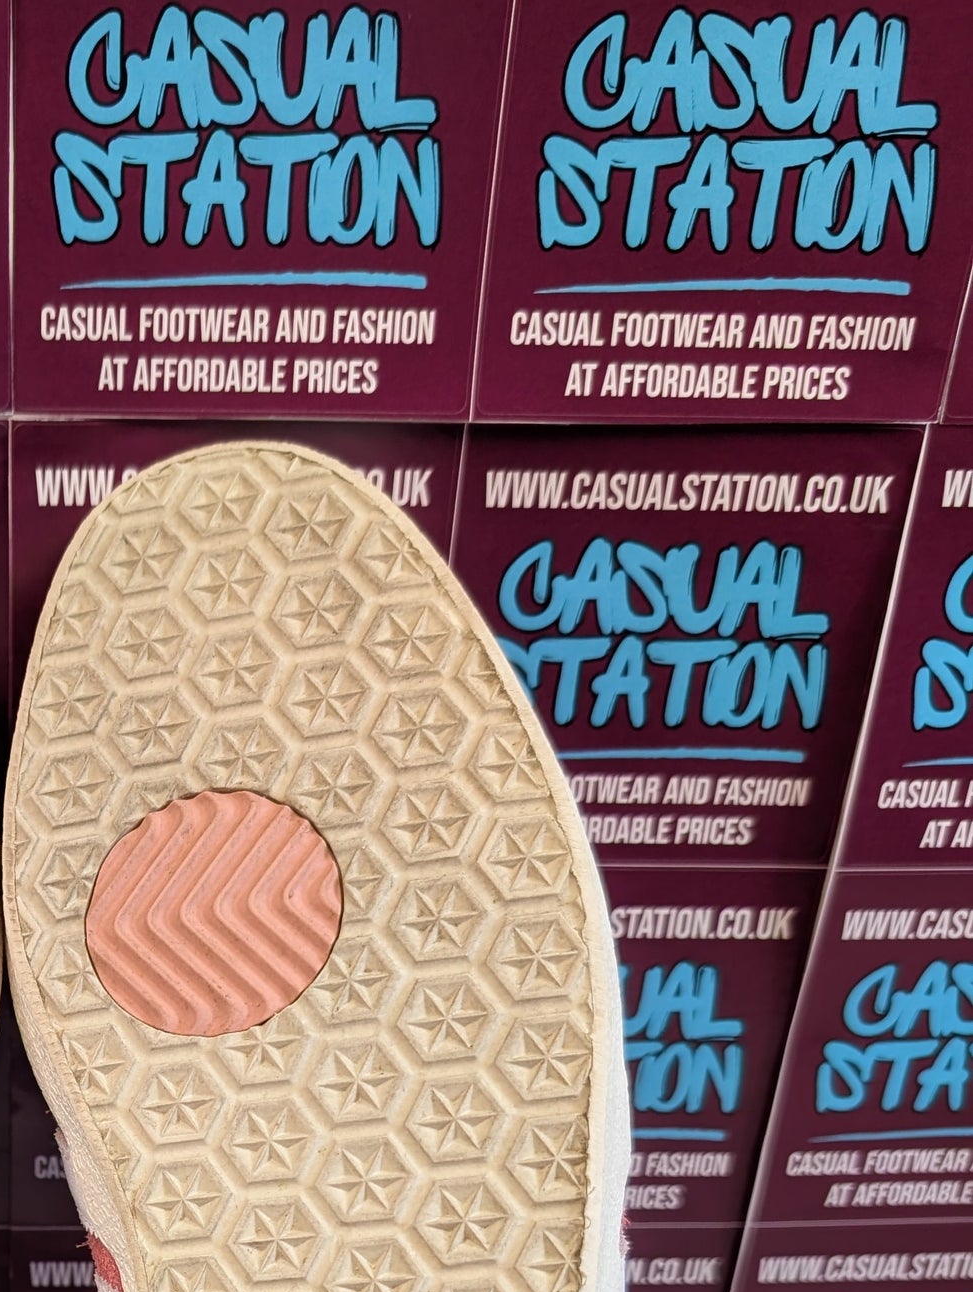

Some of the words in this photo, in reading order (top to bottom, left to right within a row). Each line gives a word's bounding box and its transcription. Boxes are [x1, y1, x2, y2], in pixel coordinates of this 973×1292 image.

[67, 4, 437, 132] CASUAL
[563, 5, 939, 136] CASUAL
[52, 129, 442, 249] STATION
[536, 133, 937, 254] STATION
[41, 306, 132, 342] CASUAL
[139, 307, 269, 344] FOOTWEAR
[275, 309, 326, 344] AND
[332, 309, 436, 345] FASHION
[510, 311, 604, 347] CASUAL
[610, 312, 744, 349] FOOTWEAR
[748, 315, 802, 351] AND
[806, 315, 916, 352] FASHION
[98, 357, 129, 391] AT
[133, 357, 286, 394] AFFORDABLE
[293, 359, 378, 395] PRICES
[565, 363, 594, 397] AT
[600, 363, 757, 400] AFFORDABLE
[762, 365, 851, 401] PRICES
[485, 471, 895, 514] WWW.CASUALSTATION.CO.UK
[498, 536, 830, 640] CASUAL
[662, 776, 711, 804] AND
[713, 777, 811, 807] FASHION
[878, 778, 960, 809] CASUAL
[674, 816, 755, 845] PRICES
[919, 818, 951, 848] AT
[645, 1152, 731, 1177] FASHION
[786, 1151, 860, 1176] CASUAL
[863, 1148, 970, 1174] FOOTWEAR
[624, 1185, 683, 1209] RICES
[823, 1182, 853, 1207] AT
